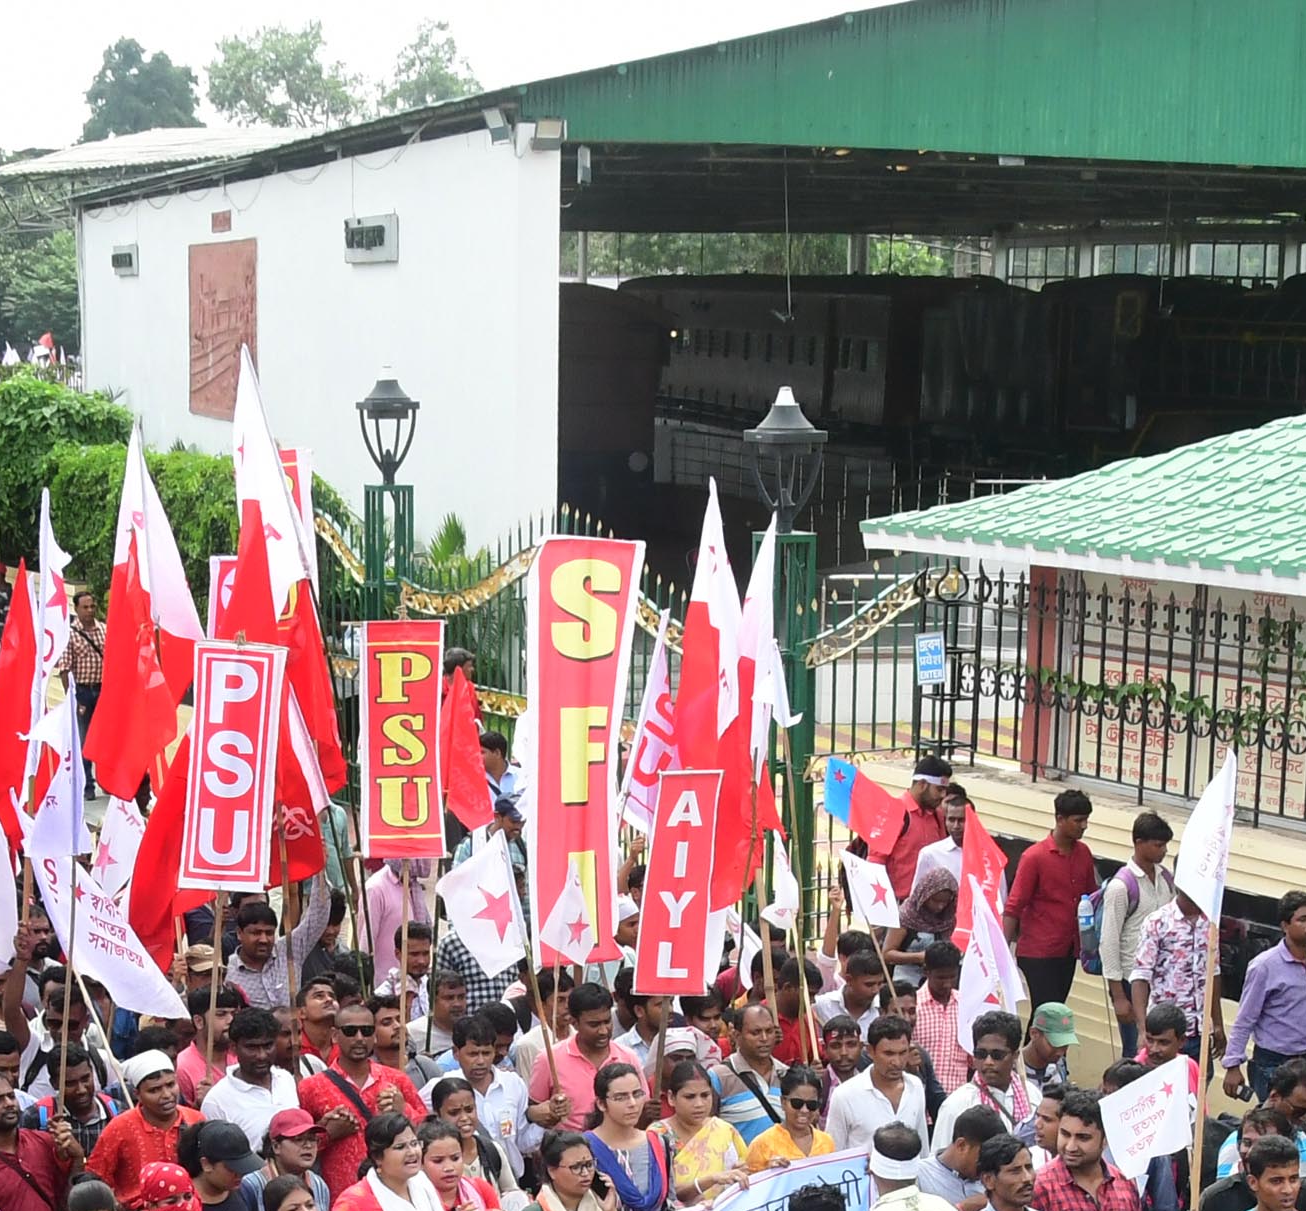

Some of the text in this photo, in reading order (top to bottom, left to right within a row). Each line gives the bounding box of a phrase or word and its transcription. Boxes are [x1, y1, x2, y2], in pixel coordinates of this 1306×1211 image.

[197, 661, 259, 866] PSU
[375, 651, 433, 828] PSU
[655, 790, 703, 979] AIYL
